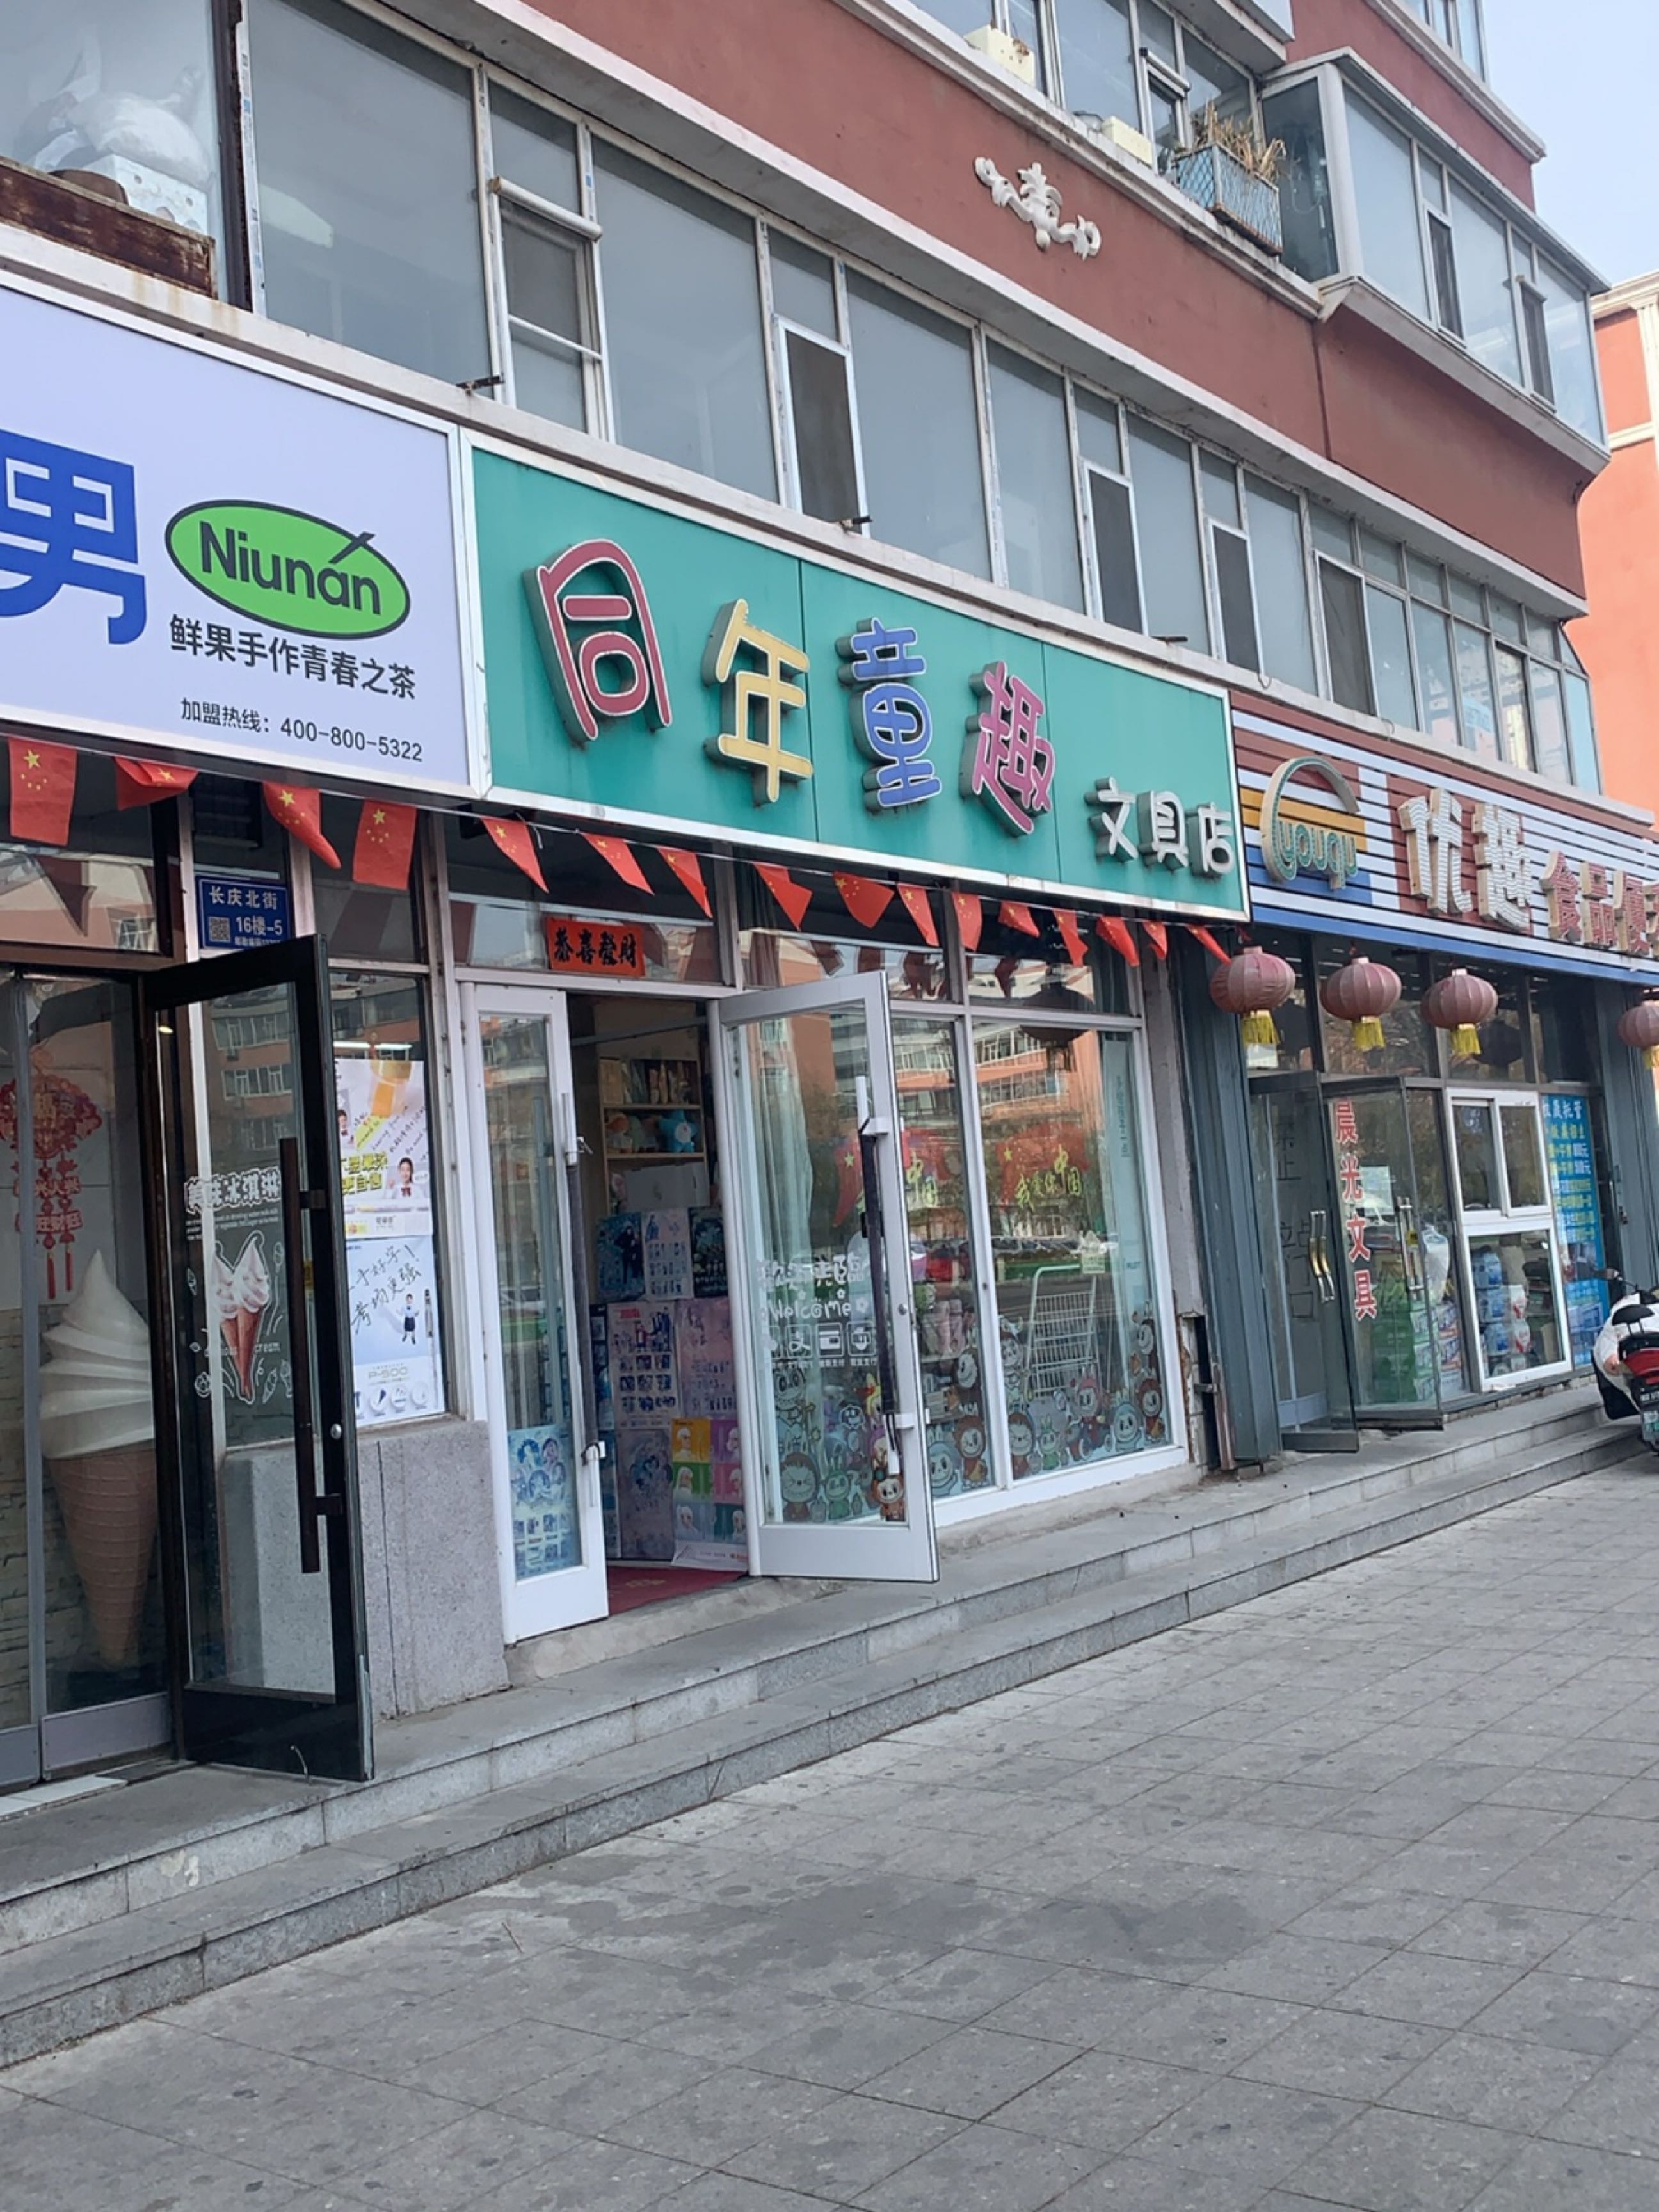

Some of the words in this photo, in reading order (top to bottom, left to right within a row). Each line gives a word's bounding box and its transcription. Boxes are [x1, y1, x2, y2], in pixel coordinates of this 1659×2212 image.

[0, 429, 147, 645] 男
[169, 614, 417, 700] 鲜果手作青春之茶
[1086, 776, 1236, 875] 文具店
[1398, 787, 1532, 932] 优趣
[209, 885, 278, 910] 长庆北街
[554, 926, 638, 968] 恭喜發財
[1336, 1099, 1377, 1321] 晨光文具
